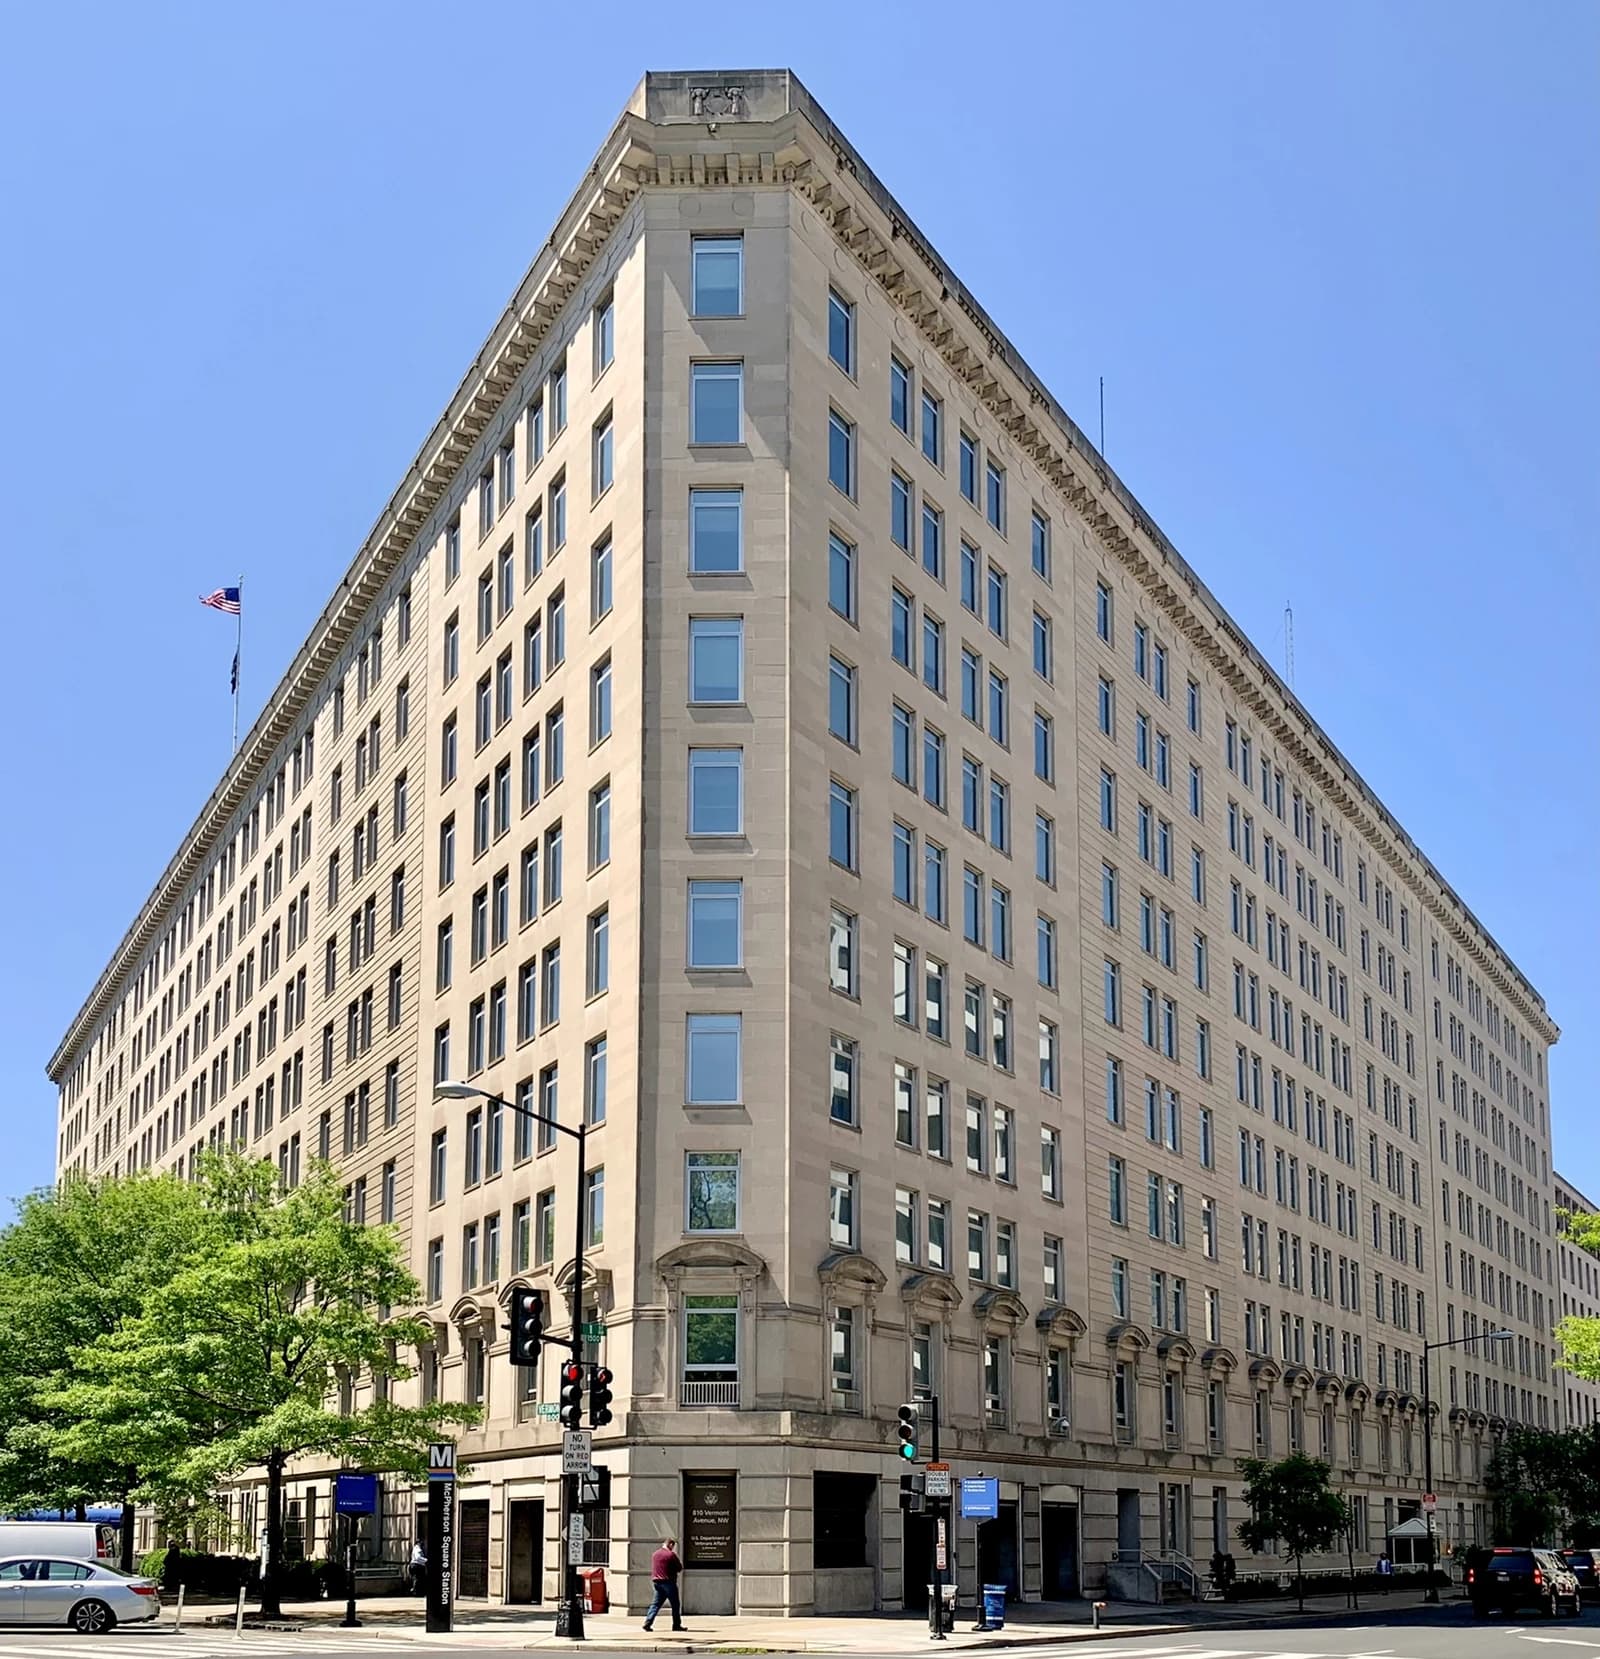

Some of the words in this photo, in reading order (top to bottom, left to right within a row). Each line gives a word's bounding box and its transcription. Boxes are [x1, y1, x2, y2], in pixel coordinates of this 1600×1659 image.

[569, 1443, 586, 1451] TURN
[572, 1434, 583, 1442] NO
[430, 1446, 452, 1467] M
[566, 1461, 588, 1469] ARROW
[443, 1483, 452, 1533] McPherson
[441, 1535, 452, 1568] Square
[441, 1571, 451, 1605] Station
